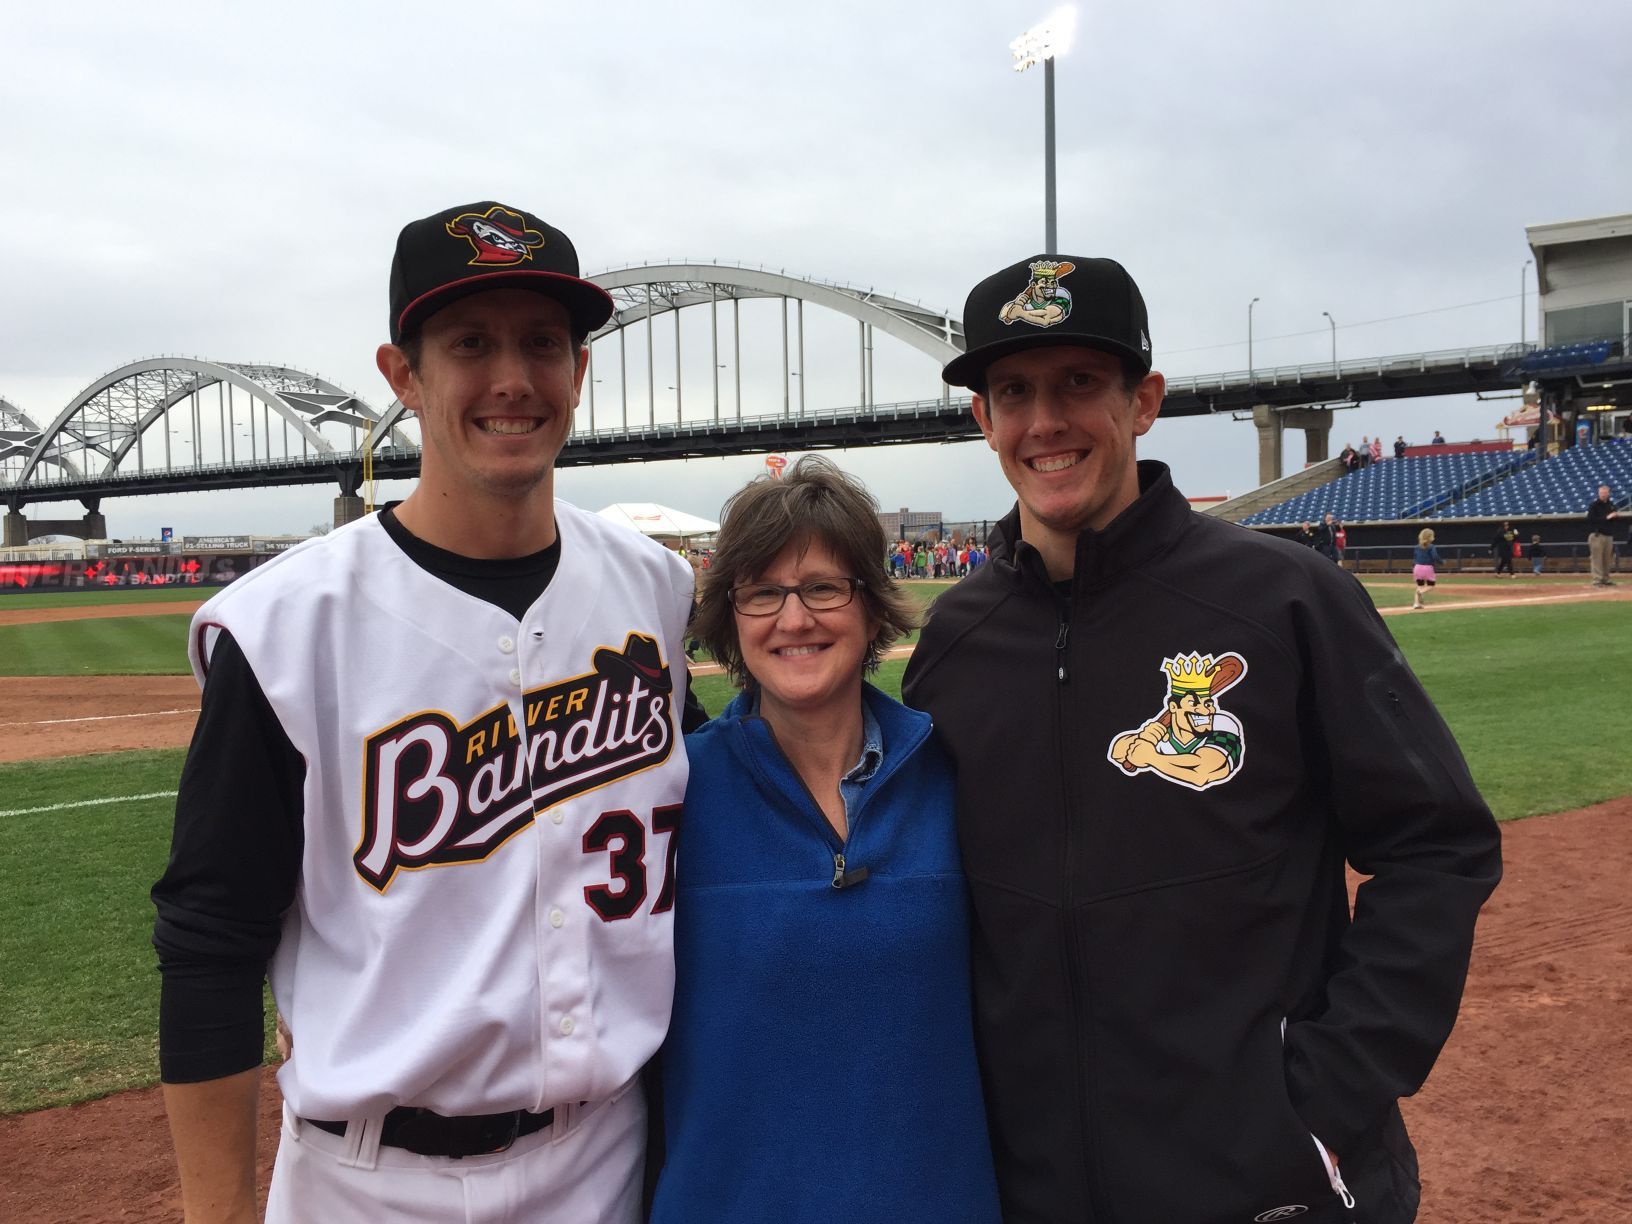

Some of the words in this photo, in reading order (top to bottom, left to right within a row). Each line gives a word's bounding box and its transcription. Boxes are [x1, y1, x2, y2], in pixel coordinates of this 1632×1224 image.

[107, 547, 128, 555] FORD
[360, 673, 670, 878] Bandits
[582, 803, 684, 923] 37
